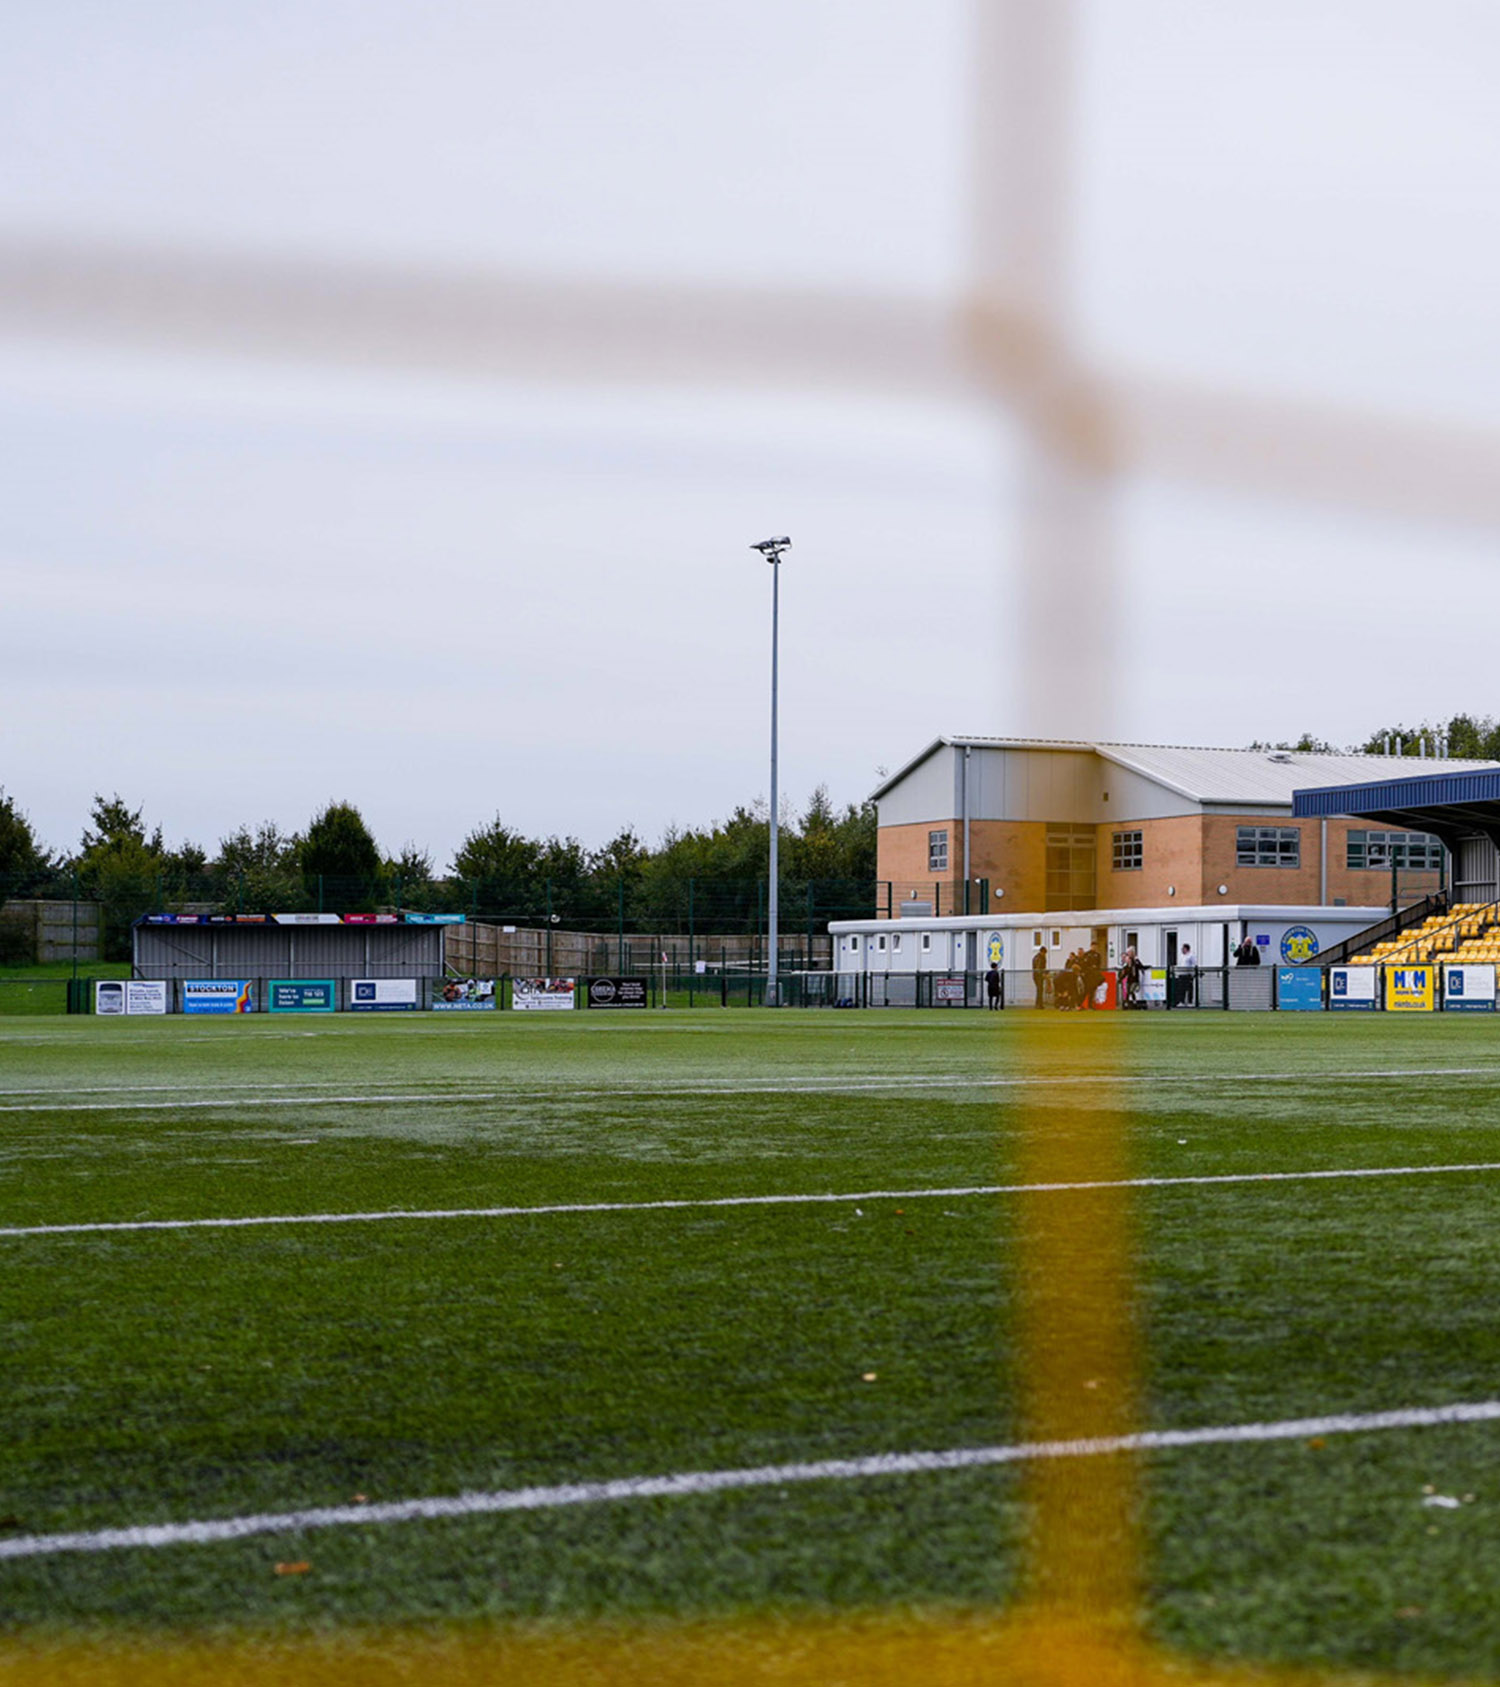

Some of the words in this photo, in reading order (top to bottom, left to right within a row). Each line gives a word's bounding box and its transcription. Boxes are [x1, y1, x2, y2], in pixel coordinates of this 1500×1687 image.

[1394, 970, 1426, 989] MKM
[189, 984, 235, 992] STOCKTON
[433, 1001, 494, 1009] WWW.NETA.CO.UK
